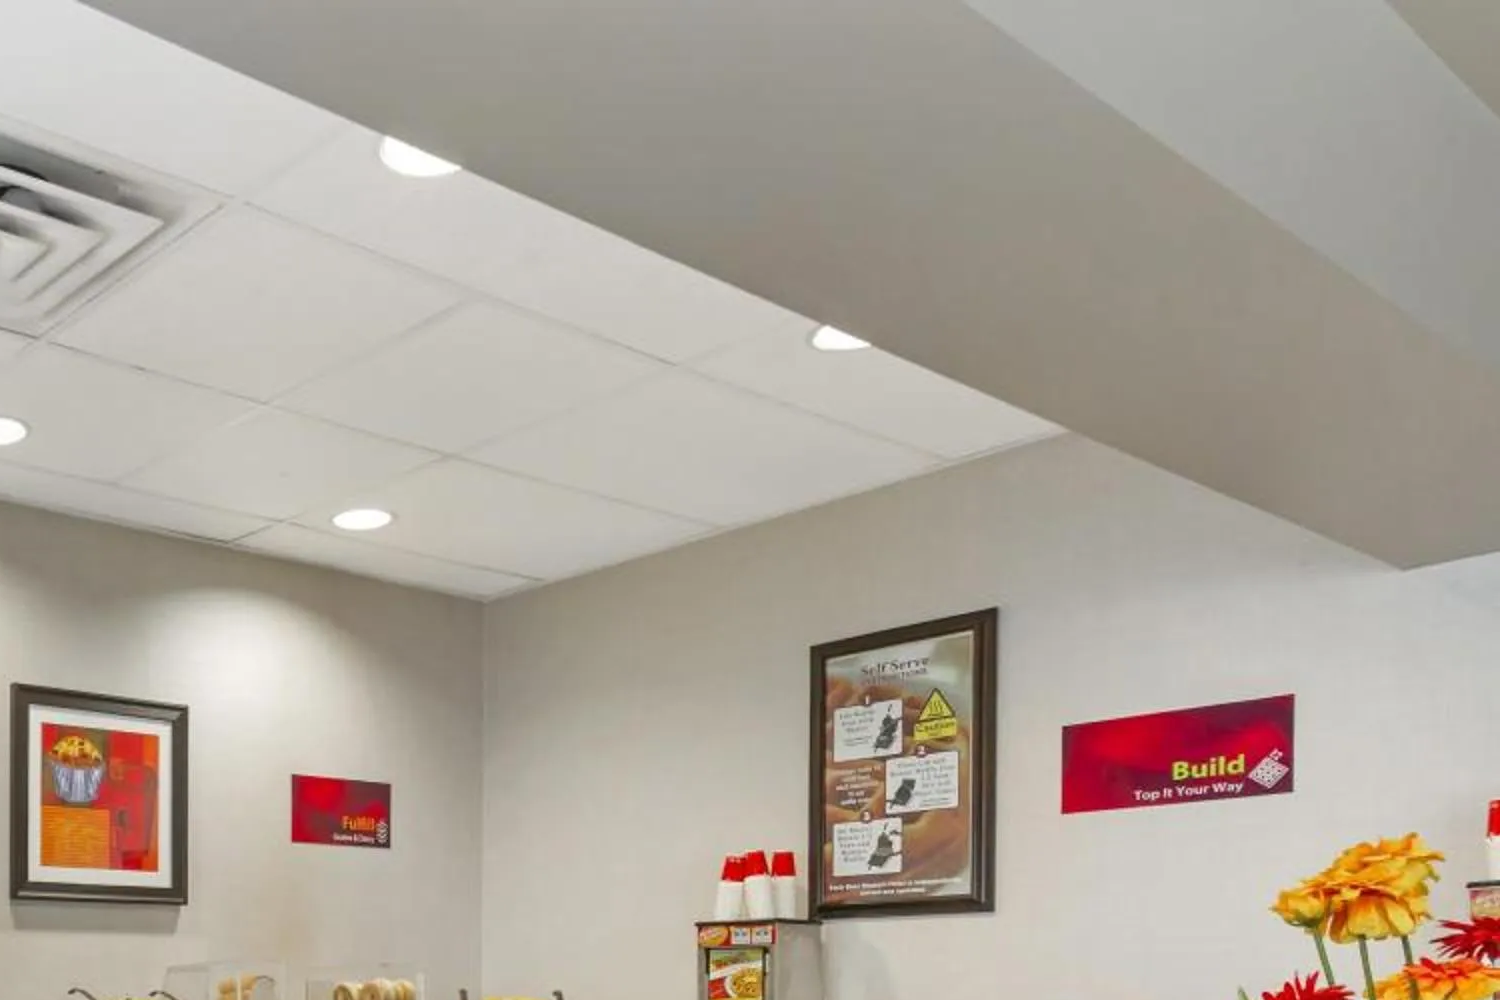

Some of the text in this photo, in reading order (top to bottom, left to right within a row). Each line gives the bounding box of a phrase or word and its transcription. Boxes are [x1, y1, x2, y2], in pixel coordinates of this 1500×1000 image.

[861, 658, 929, 675] Self Serve
[1172, 753, 1246, 781] Build
[1134, 782, 1244, 801] Top It Your Way
